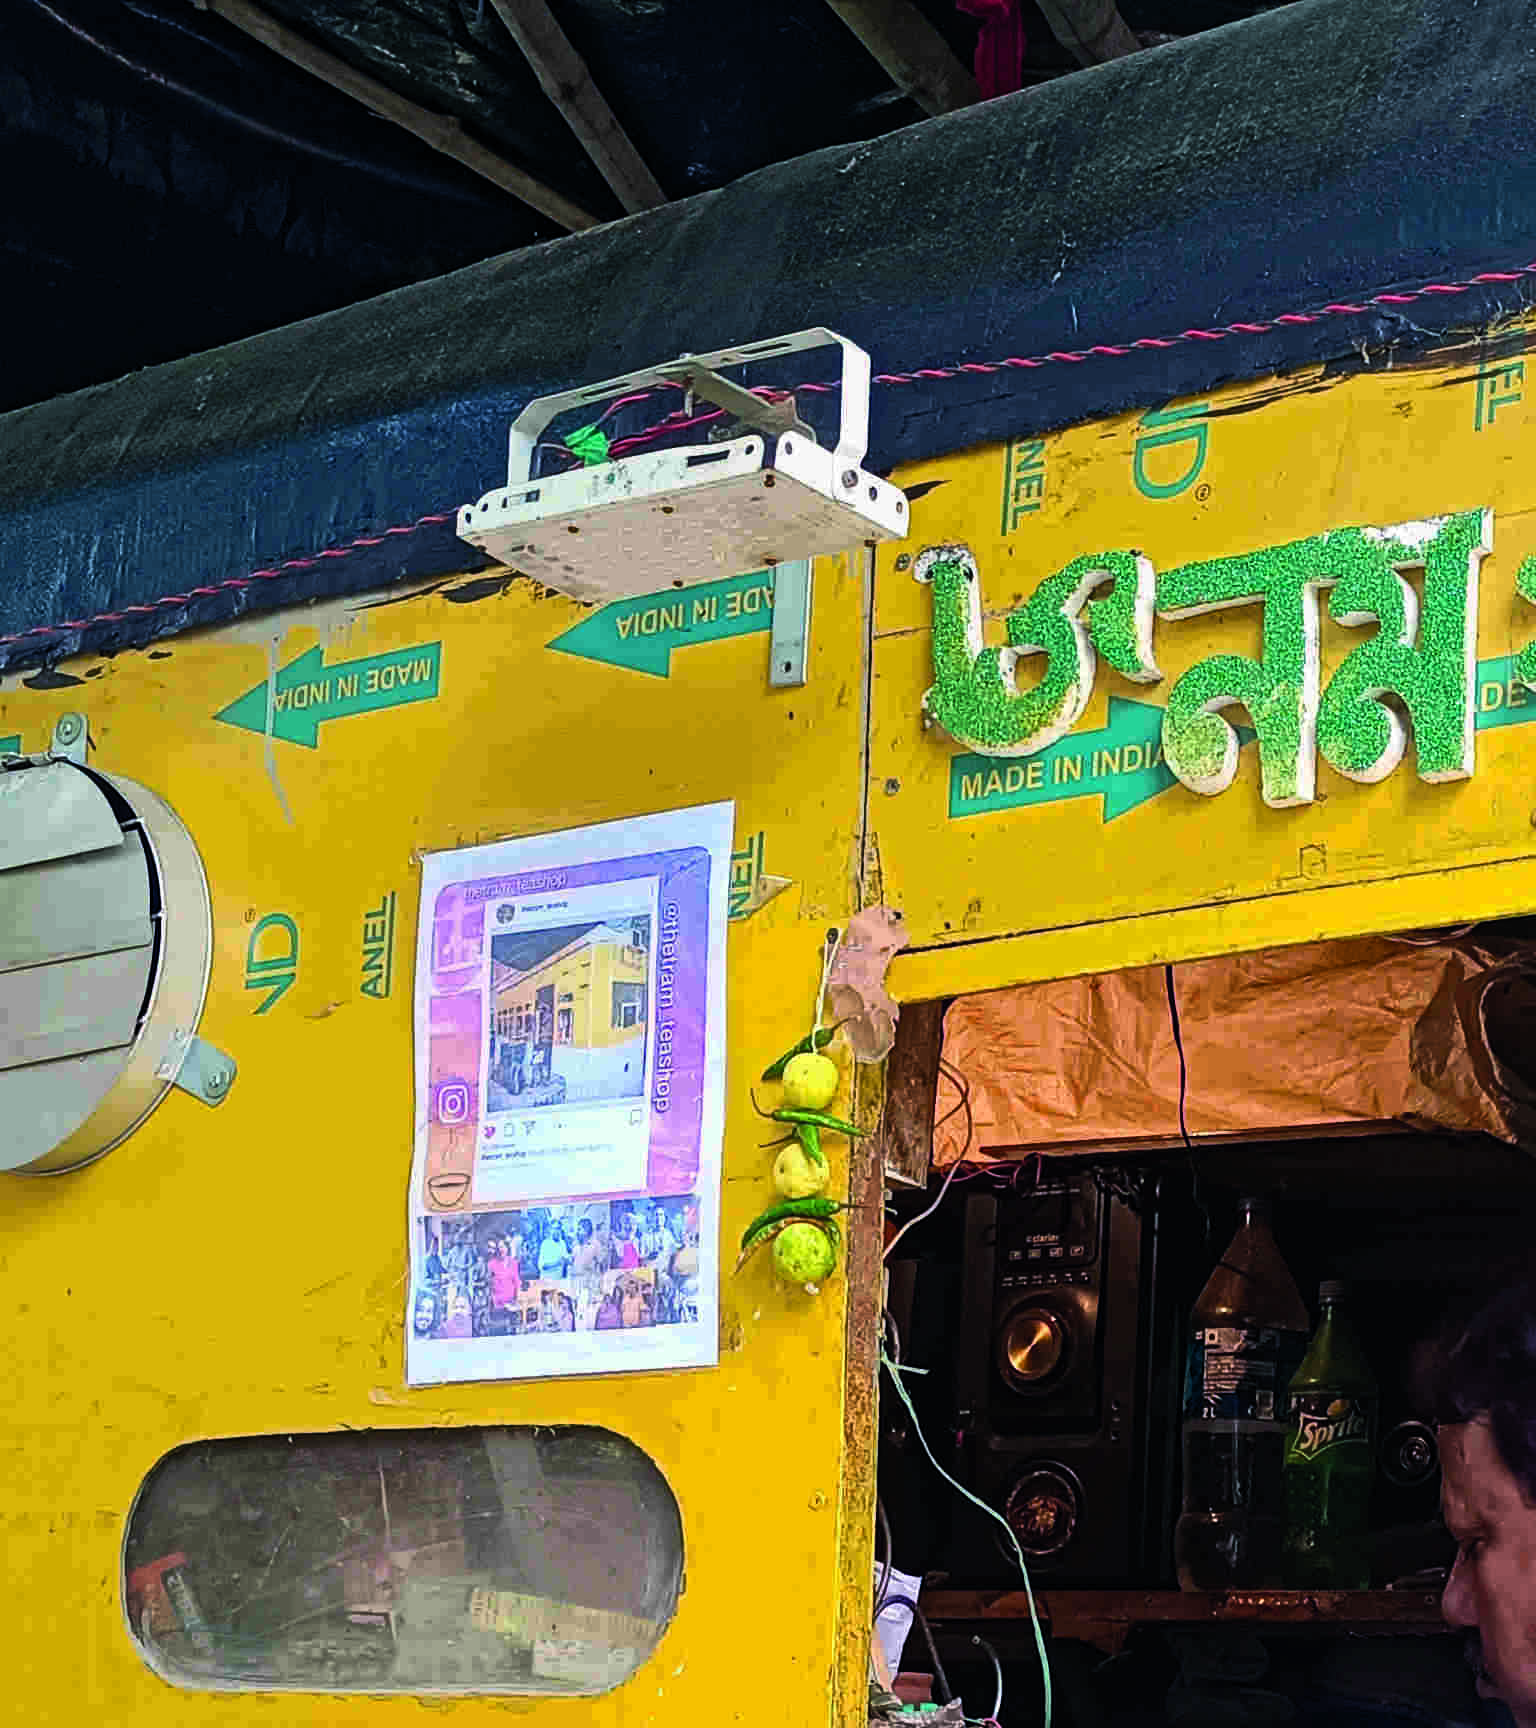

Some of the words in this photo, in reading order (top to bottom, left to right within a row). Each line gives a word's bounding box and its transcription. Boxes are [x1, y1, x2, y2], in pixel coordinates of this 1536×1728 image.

[725, 583, 775, 618] ADE
[616, 602, 684, 641] INDIA
[336, 674, 358, 703] IN
[364, 658, 432, 695] MADE
[960, 756, 1043, 802] MADE
[1050, 748, 1084, 784] IN
